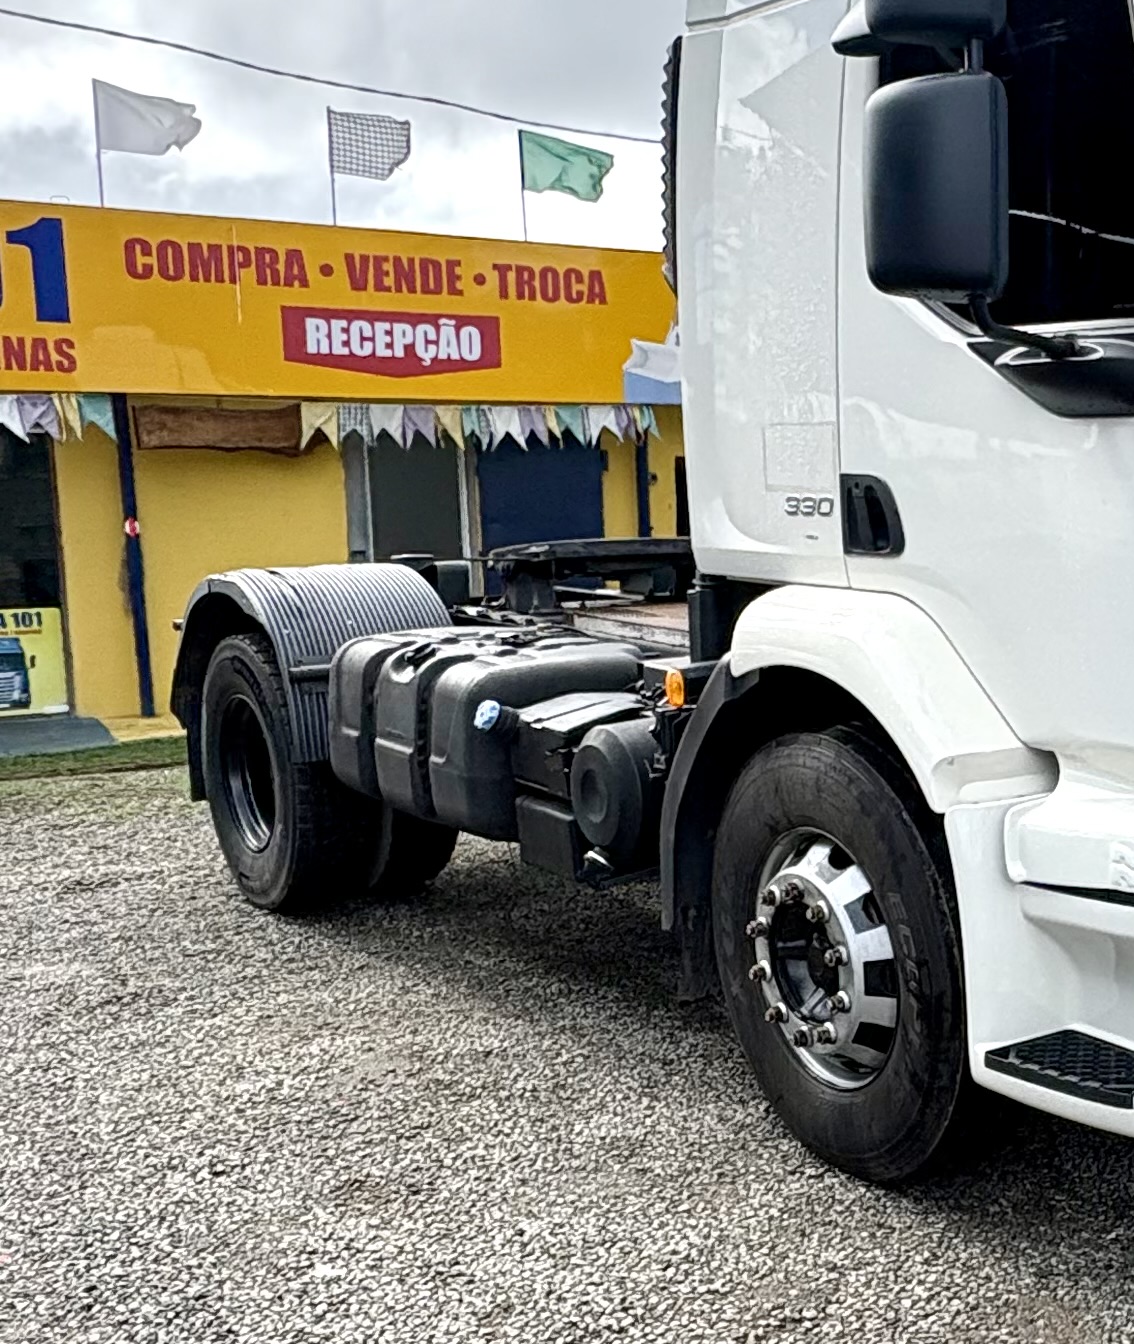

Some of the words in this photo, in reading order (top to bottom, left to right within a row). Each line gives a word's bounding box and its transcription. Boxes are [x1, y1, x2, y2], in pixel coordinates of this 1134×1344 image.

[0, 216, 71, 323] 1
[124, 237, 310, 288] COMPRA
[344, 252, 464, 296] VENDE
[492, 262, 608, 305] TROCA
[0, 335, 77, 374] NAS
[304, 317, 482, 366] RECEPÇÃO
[784, 496, 834, 516] 330
[10, 611, 42, 628] 101
